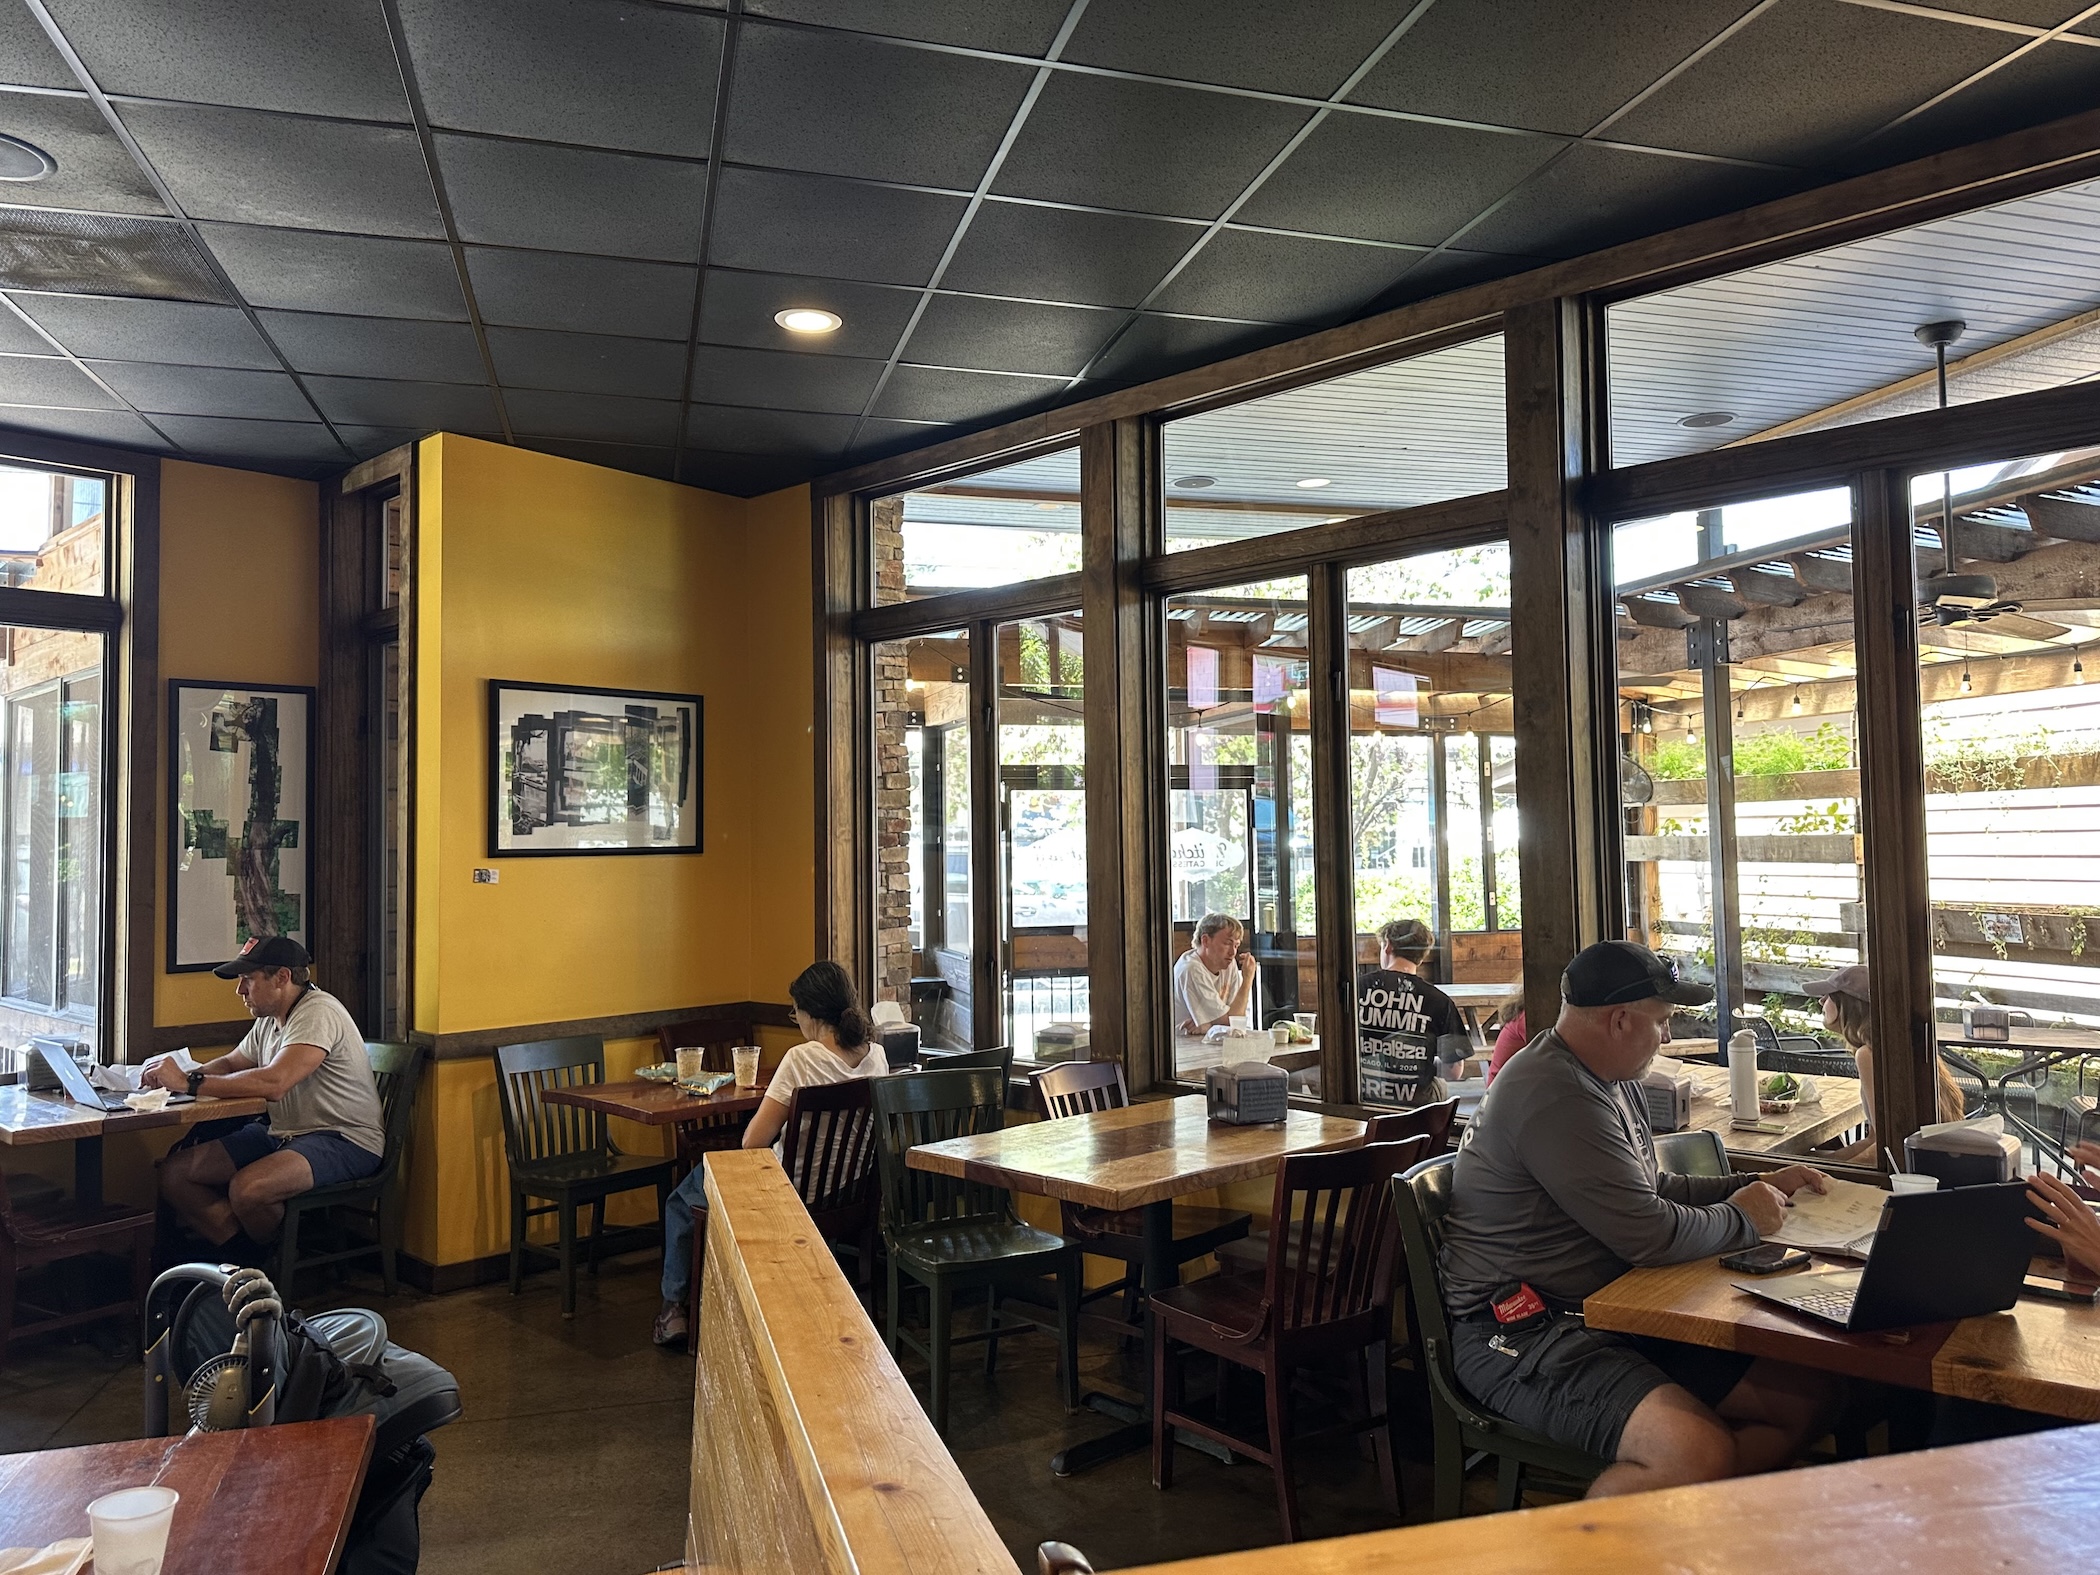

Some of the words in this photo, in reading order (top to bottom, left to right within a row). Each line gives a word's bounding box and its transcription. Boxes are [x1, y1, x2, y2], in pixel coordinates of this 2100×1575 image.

[1359, 988, 1424, 1013] JOHN
[1359, 1006, 1432, 1034] UMMIT
[1361, 1036, 1428, 1060] lapalooza
